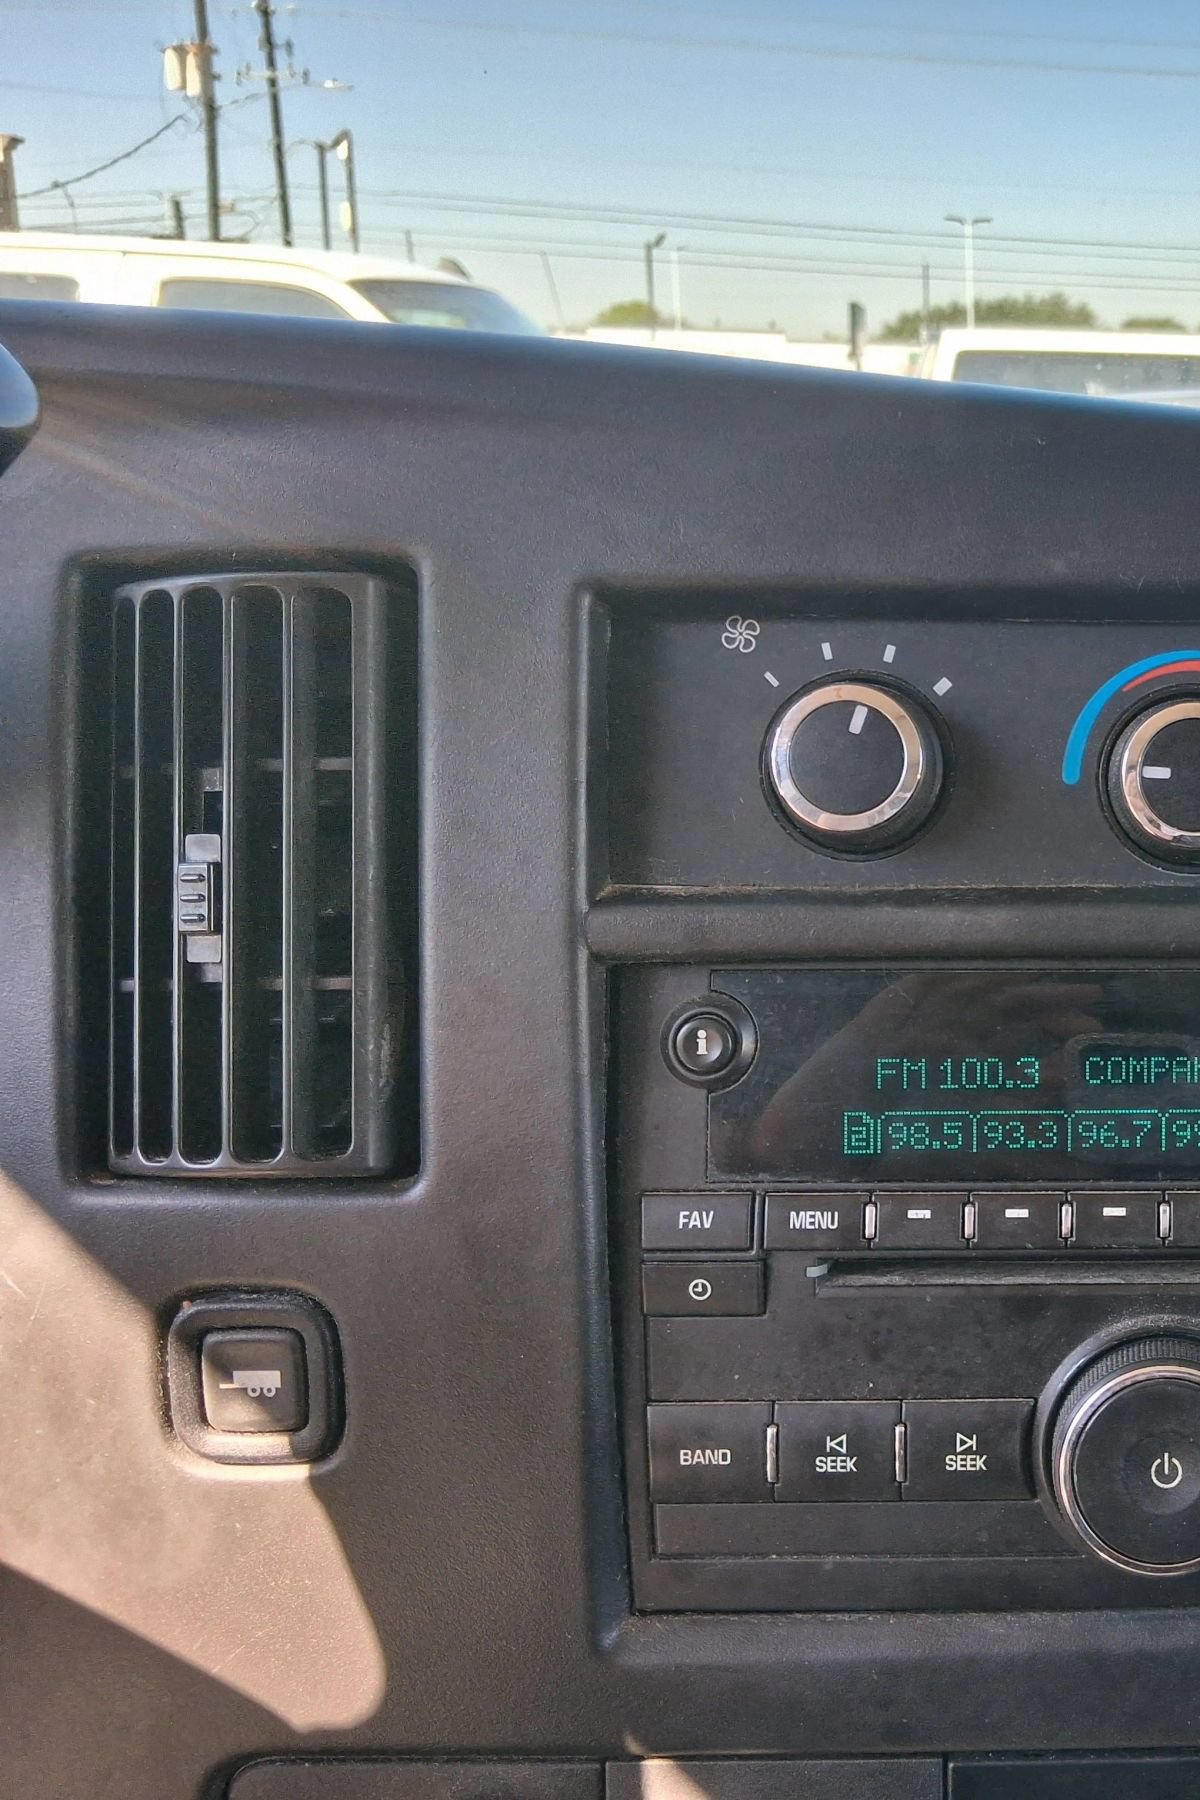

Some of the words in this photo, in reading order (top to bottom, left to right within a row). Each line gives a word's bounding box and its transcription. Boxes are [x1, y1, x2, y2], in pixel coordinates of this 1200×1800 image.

[877, 1057, 926, 1089] FM
[939, 1056, 1040, 1088] 100.3
[888, 1122, 963, 1149] 98.5
[984, 1121, 1057, 1148] 93.3
[1078, 1120, 1151, 1148] 96.7
[678, 1210, 714, 1229] FAV
[789, 1211, 839, 1229] MENU
[679, 1449, 732, 1466] BAND
[815, 1456, 858, 1473] SEEK
[944, 1454, 987, 1472] SEEK
